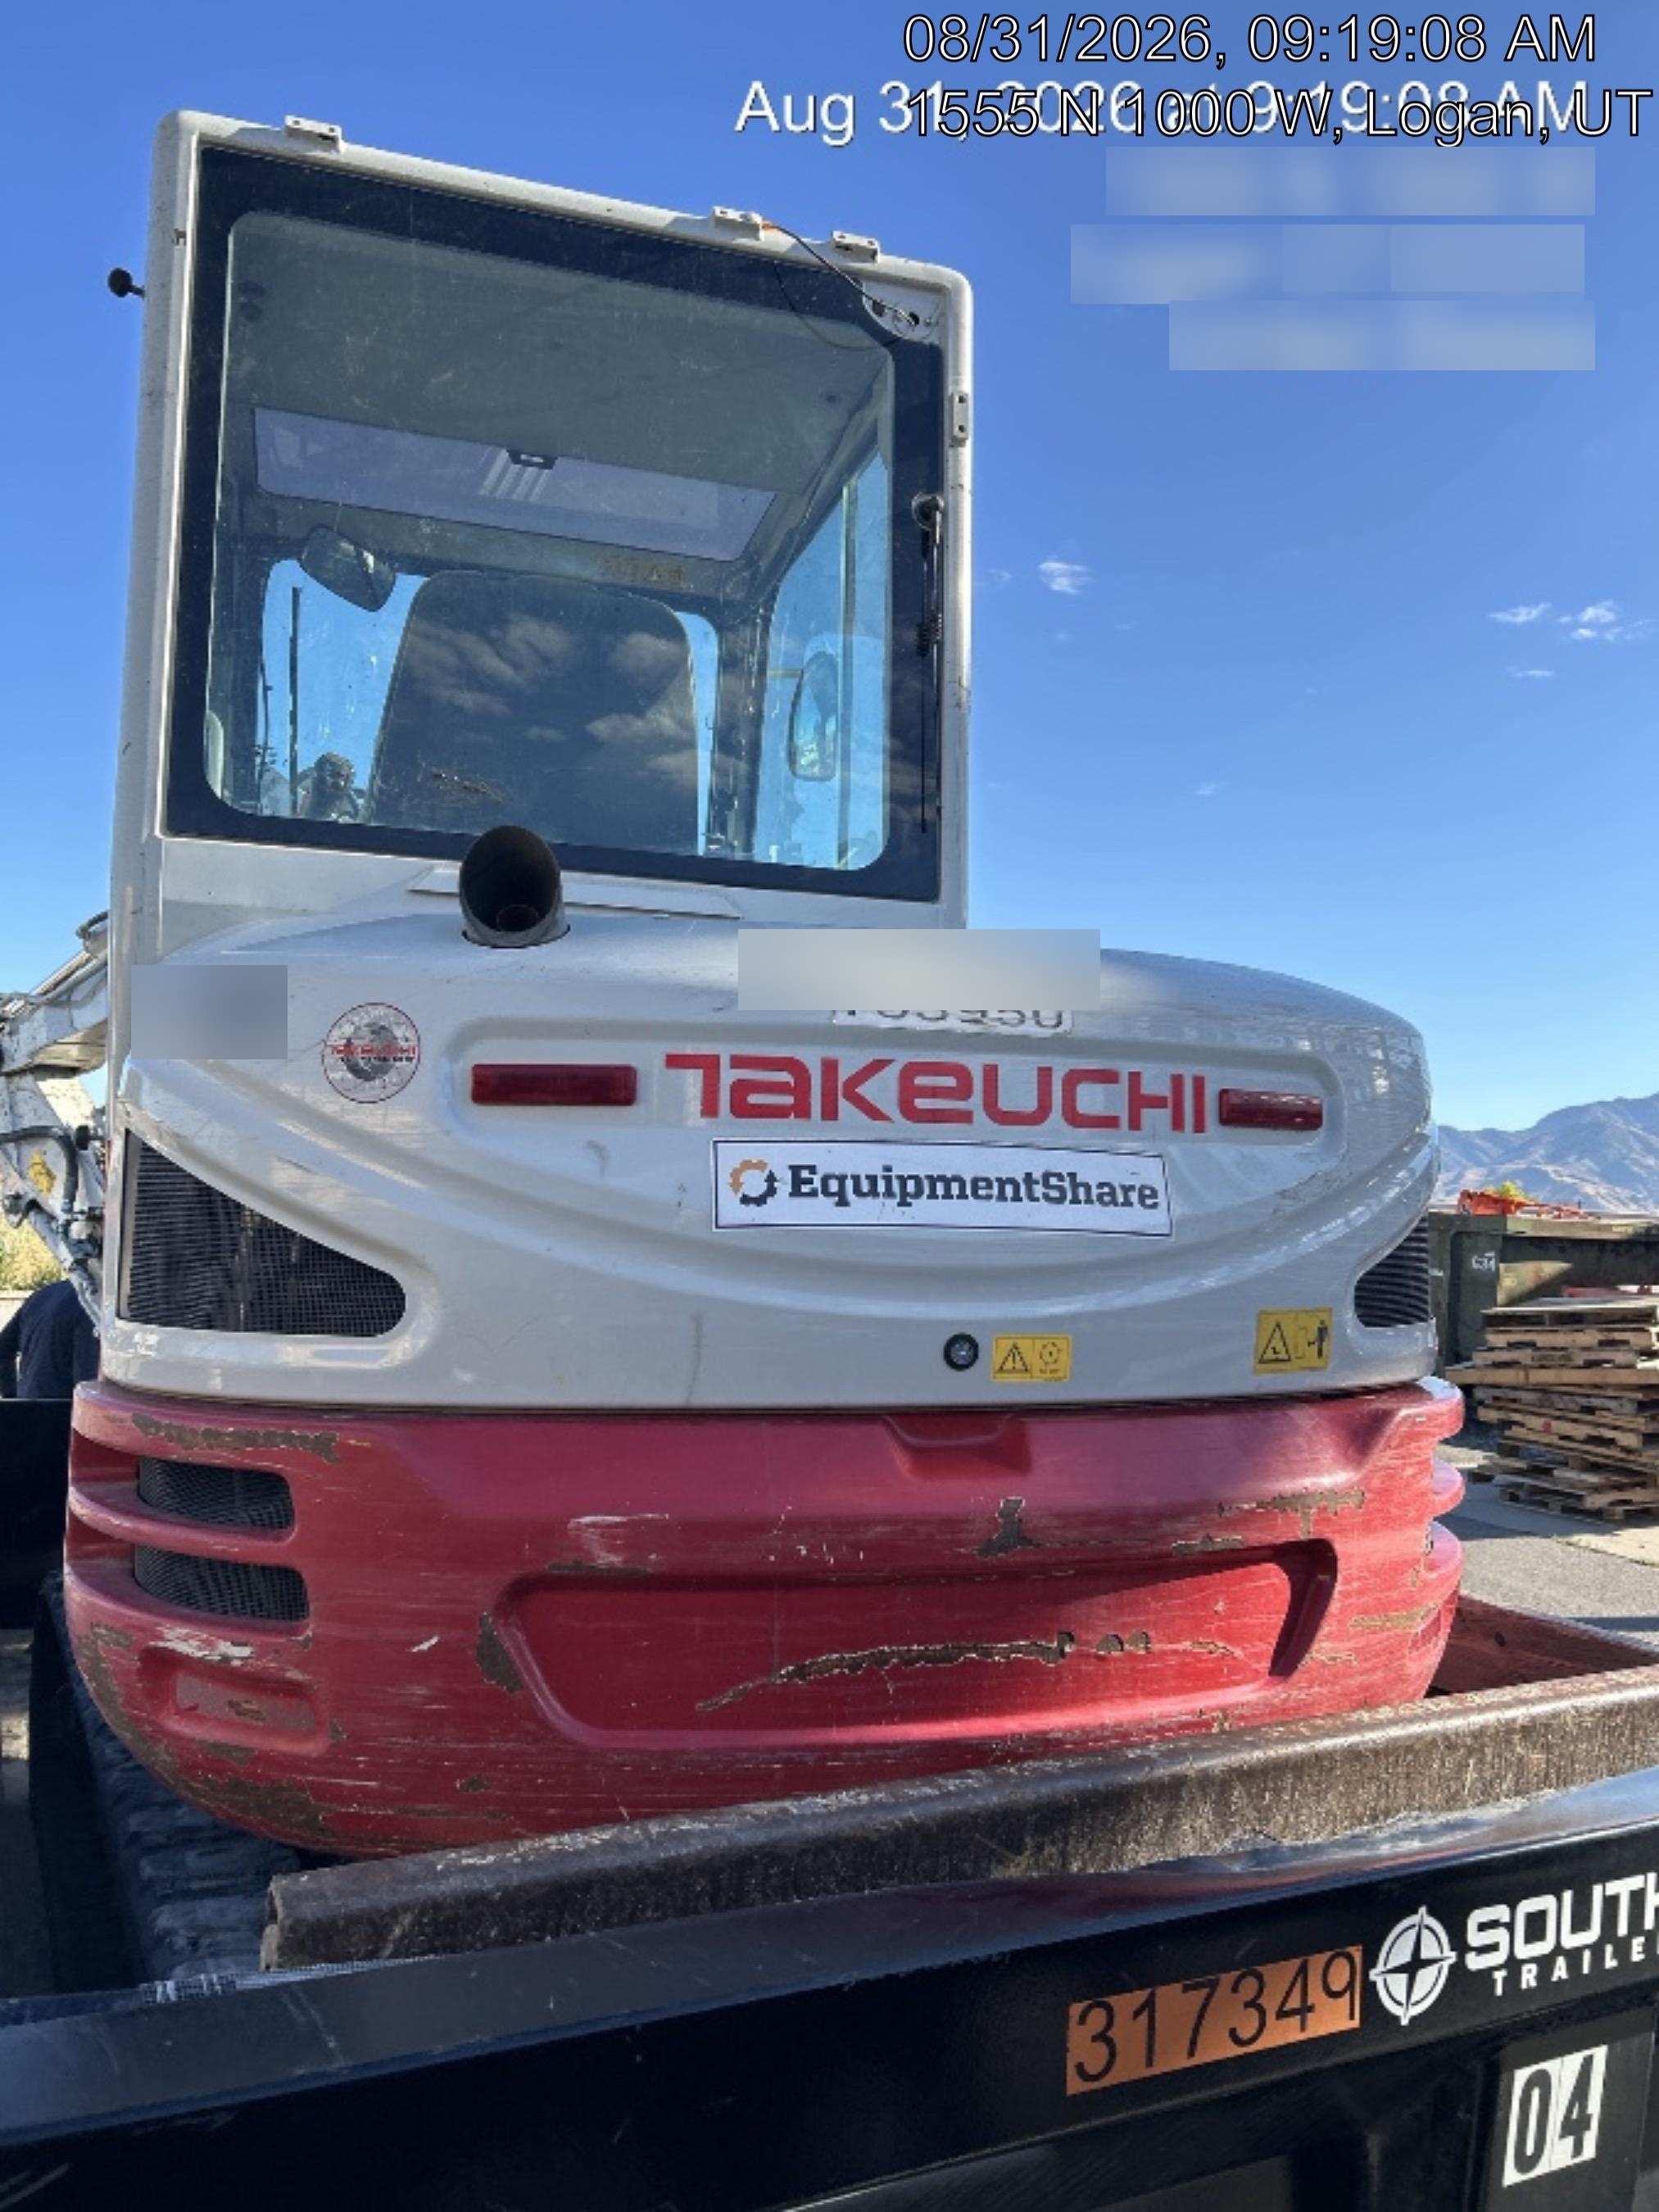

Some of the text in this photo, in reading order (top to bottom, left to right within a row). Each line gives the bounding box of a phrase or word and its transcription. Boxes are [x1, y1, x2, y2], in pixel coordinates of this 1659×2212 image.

[787, 1163, 1160, 1211] EquipmentShare
[1492, 1928, 1659, 1997] TRAILE
[1074, 1950, 1358, 2084] 317349
[1512, 2053, 1596, 2177] 04
